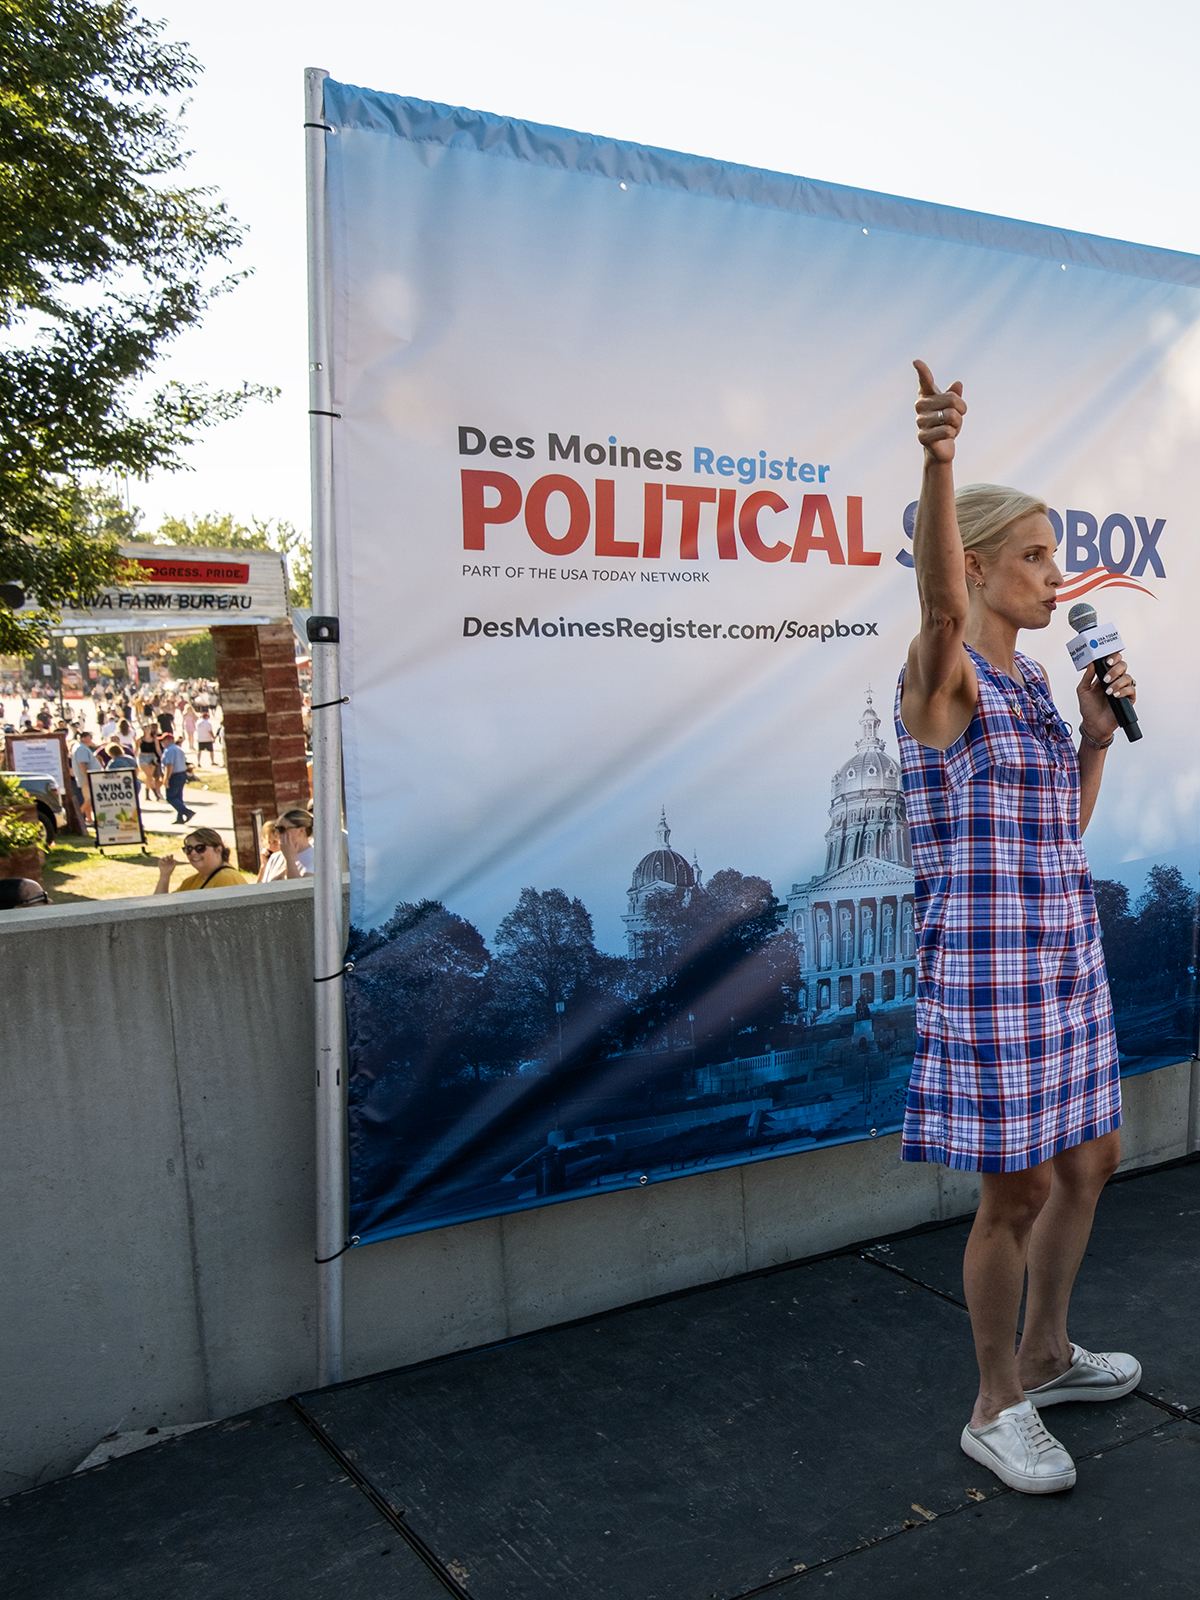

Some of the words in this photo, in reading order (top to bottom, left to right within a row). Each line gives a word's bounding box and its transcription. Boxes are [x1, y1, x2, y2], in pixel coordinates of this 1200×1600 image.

[458, 426, 535, 459] Des
[548, 432, 682, 472] Moines
[693, 446, 830, 484] Register
[460, 469, 882, 567] POLITICAL
[206, 568, 244, 579] PRIDE.
[462, 565, 501, 579] PART
[505, 566, 525, 579] OF
[529, 567, 557, 580] THE
[560, 568, 588, 581] USA
[592, 569, 637, 583] TODAY
[641, 572, 710, 583] NETWORK
[118, 593, 174, 610] FARM
[178, 593, 252, 610] BUREAU
[463, 616, 879, 643] DesMoinesRegister.com/Soapbox
[99, 782, 122, 793] WIN
[96, 791, 133, 802] $1,000
